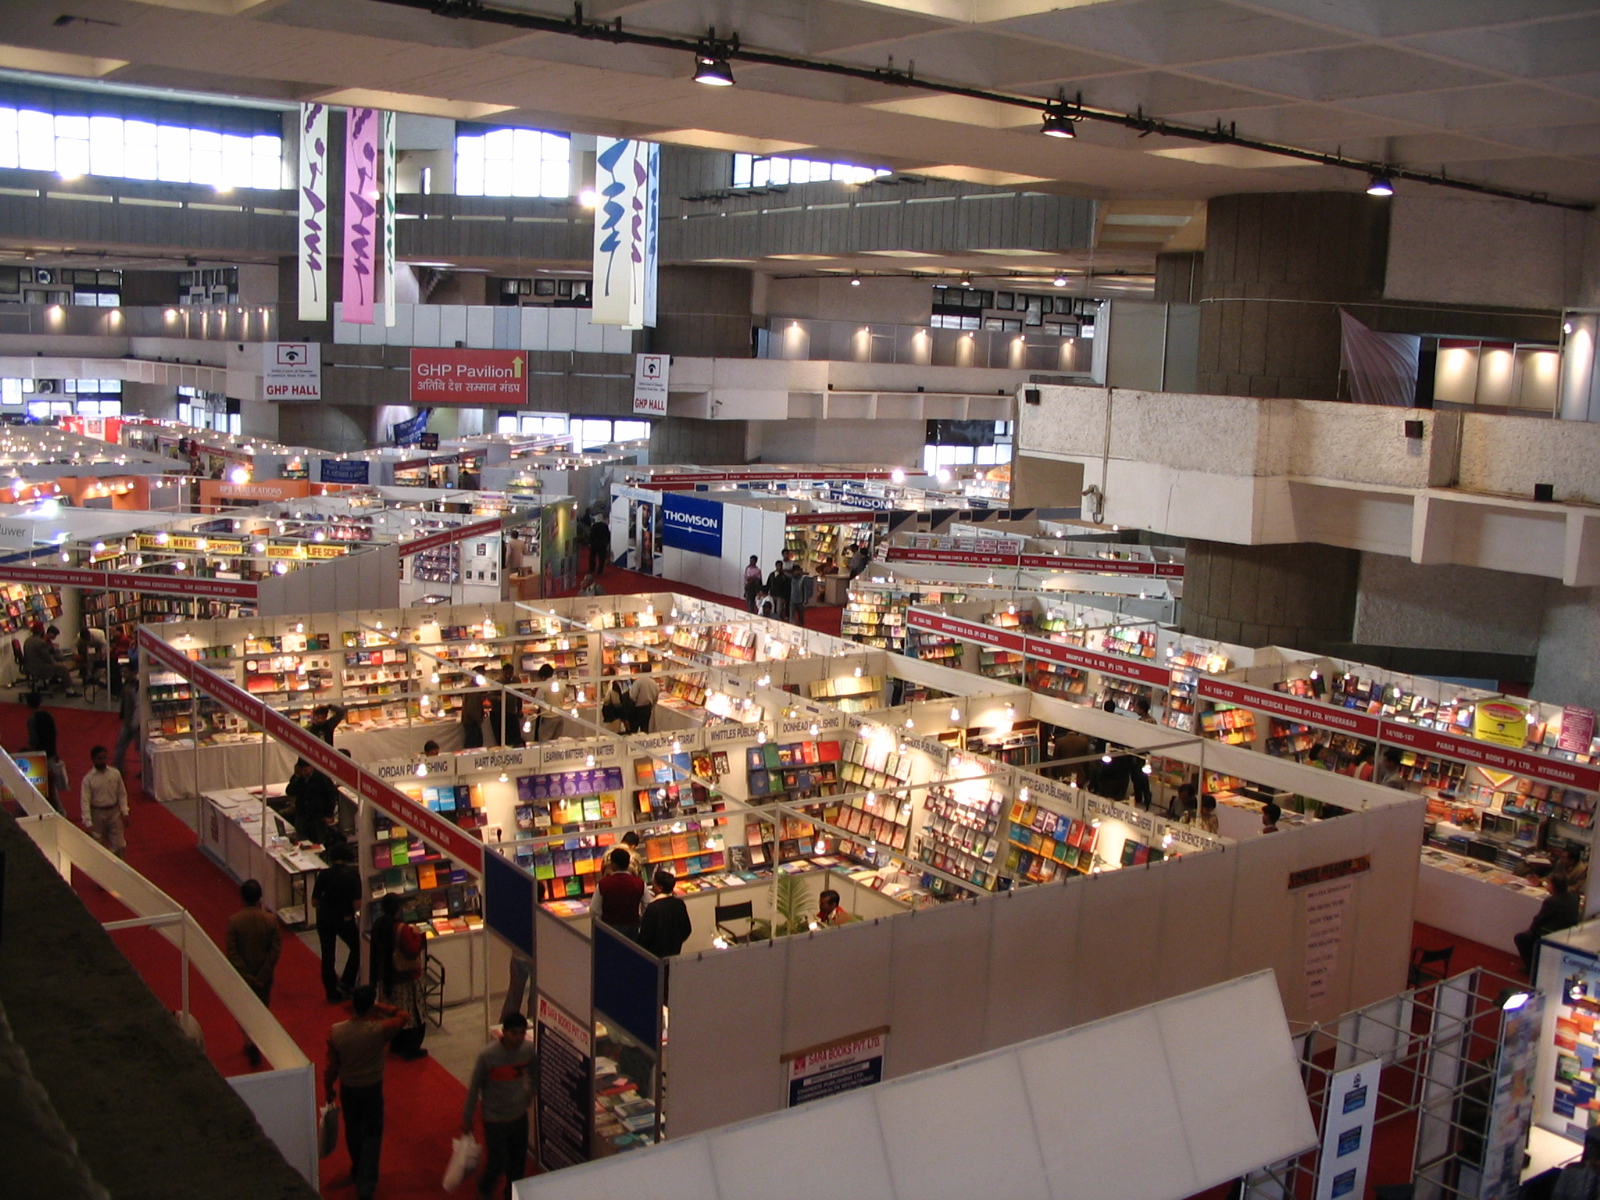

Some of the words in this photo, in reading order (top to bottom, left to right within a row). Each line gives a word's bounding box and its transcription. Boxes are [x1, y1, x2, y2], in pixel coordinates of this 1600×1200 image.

[417, 363, 452, 377] GHP
[457, 364, 513, 378] Pavilion
[266, 385, 289, 396] GHP
[291, 385, 319, 396] HALL
[417, 378, 445, 391] अतिथि
[448, 379, 463, 392] देश
[465, 382, 497, 392] सम्मान
[499, 380, 520, 392] मंडप
[634, 397, 648, 409] GHP
[648, 399, 665, 411] HALL
[234, 485, 283, 495] PUBLICATIONS
[663, 509, 718, 529] THOMSON
[173, 537, 197, 548] MATHS
[309, 546, 322, 556] LIFE
[1127, 667, 1140, 676] DELHI
[1243, 694, 1261, 705] PARAS
[1261, 697, 1284, 711] MEDICAL
[1284, 703, 1303, 715] BOOKS
[1303, 708, 1312, 717] (P)
[1324, 713, 1358, 728] HYDERABAD
[782, 720, 809, 733] DONHEAD
[710, 729, 736, 741] WHITTLES
[543, 750, 565, 763] LEARNING
[565, 748, 584, 760] MATTERS
[595, 744, 615, 756] MATTERS
[474, 757, 490, 770] HART
[1435, 741, 1455, 752] PARAS
[1457, 746, 1483, 759] MEDICAL
[1485, 753, 1505, 764] BOOKS
[1507, 758, 1517, 768] (P)
[1538, 765, 1576, 781] HYDERABAD
[1045, 782, 1073, 804] PUBLISHING
[1101, 803, 1125, 821] ACADEMIC
[1181, 827, 1200, 847] SCIENCE
[828, 1043, 853, 1060] BOOKS
